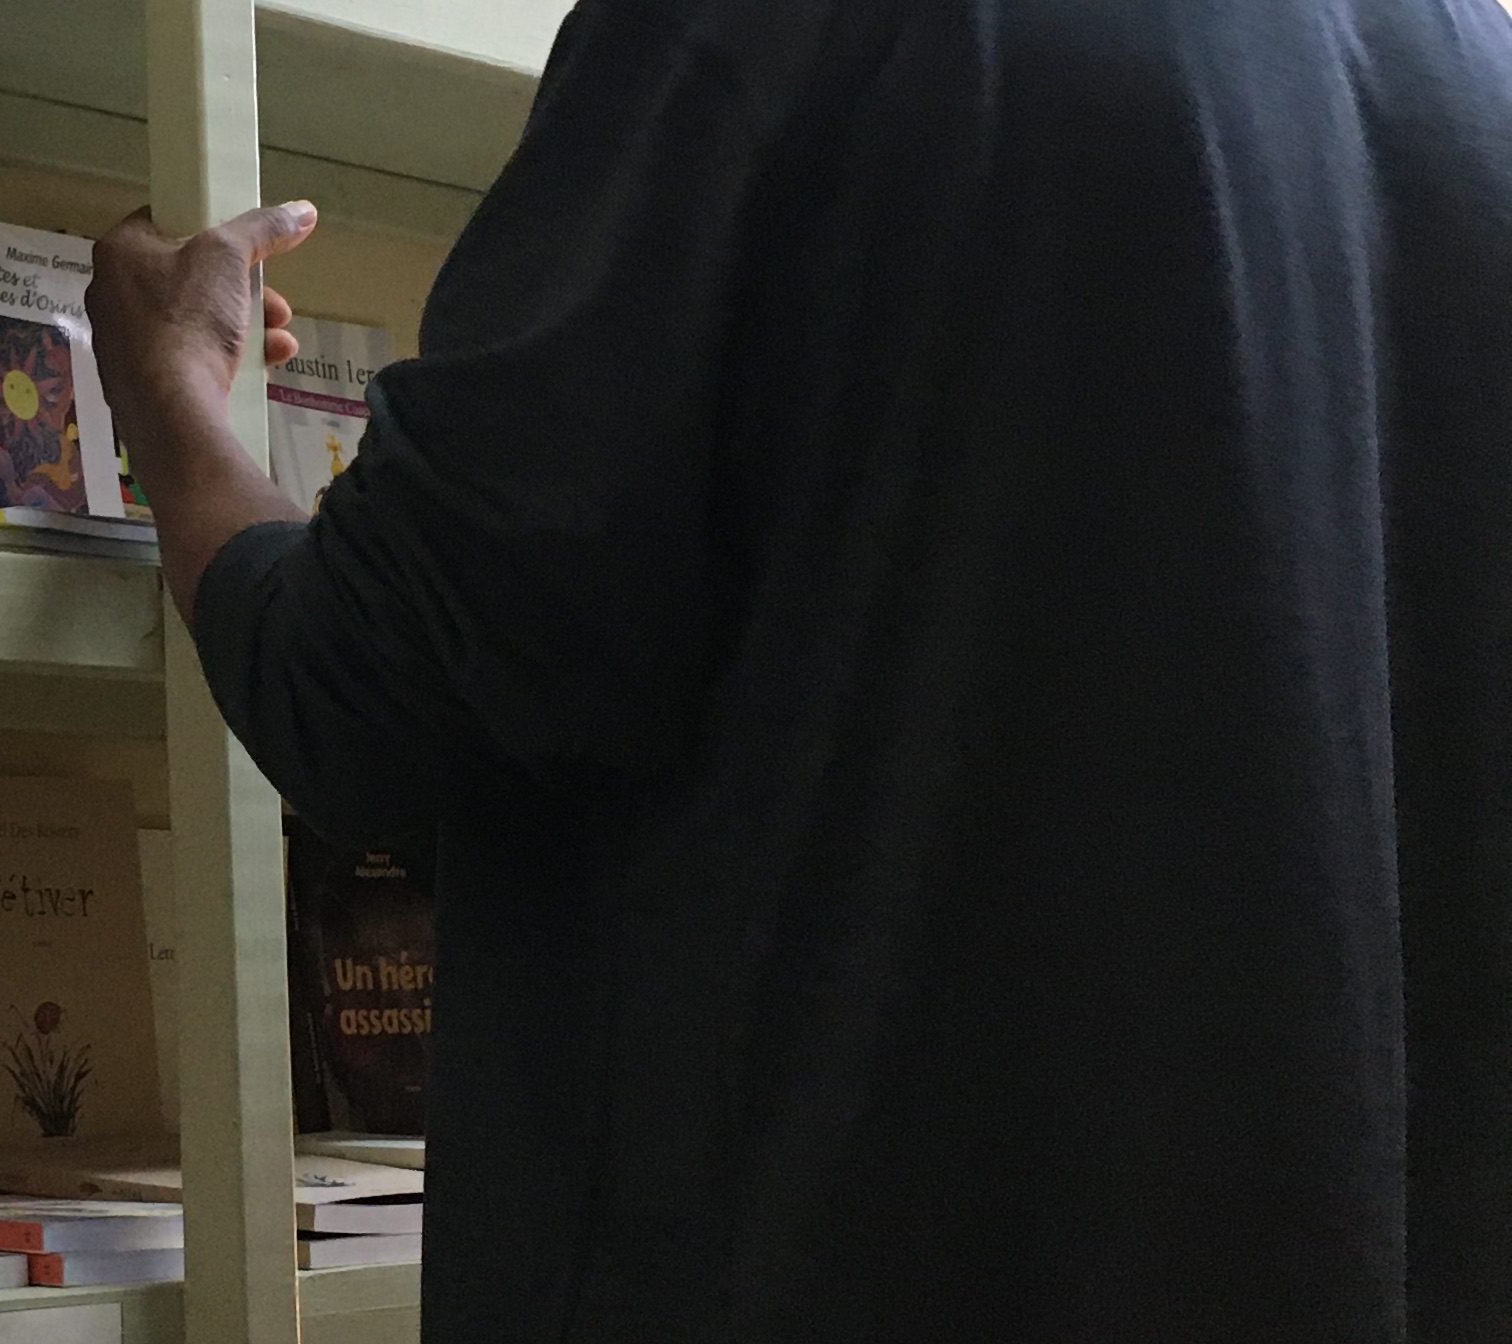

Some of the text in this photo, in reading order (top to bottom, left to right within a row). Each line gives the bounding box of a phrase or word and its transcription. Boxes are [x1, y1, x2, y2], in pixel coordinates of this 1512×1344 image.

[5, 246, 50, 267] Maxime
[22, 274, 41, 288] et
[275, 355, 339, 381] austin
[334, 957, 375, 992] Un
[339, 997, 432, 1037] assassi
